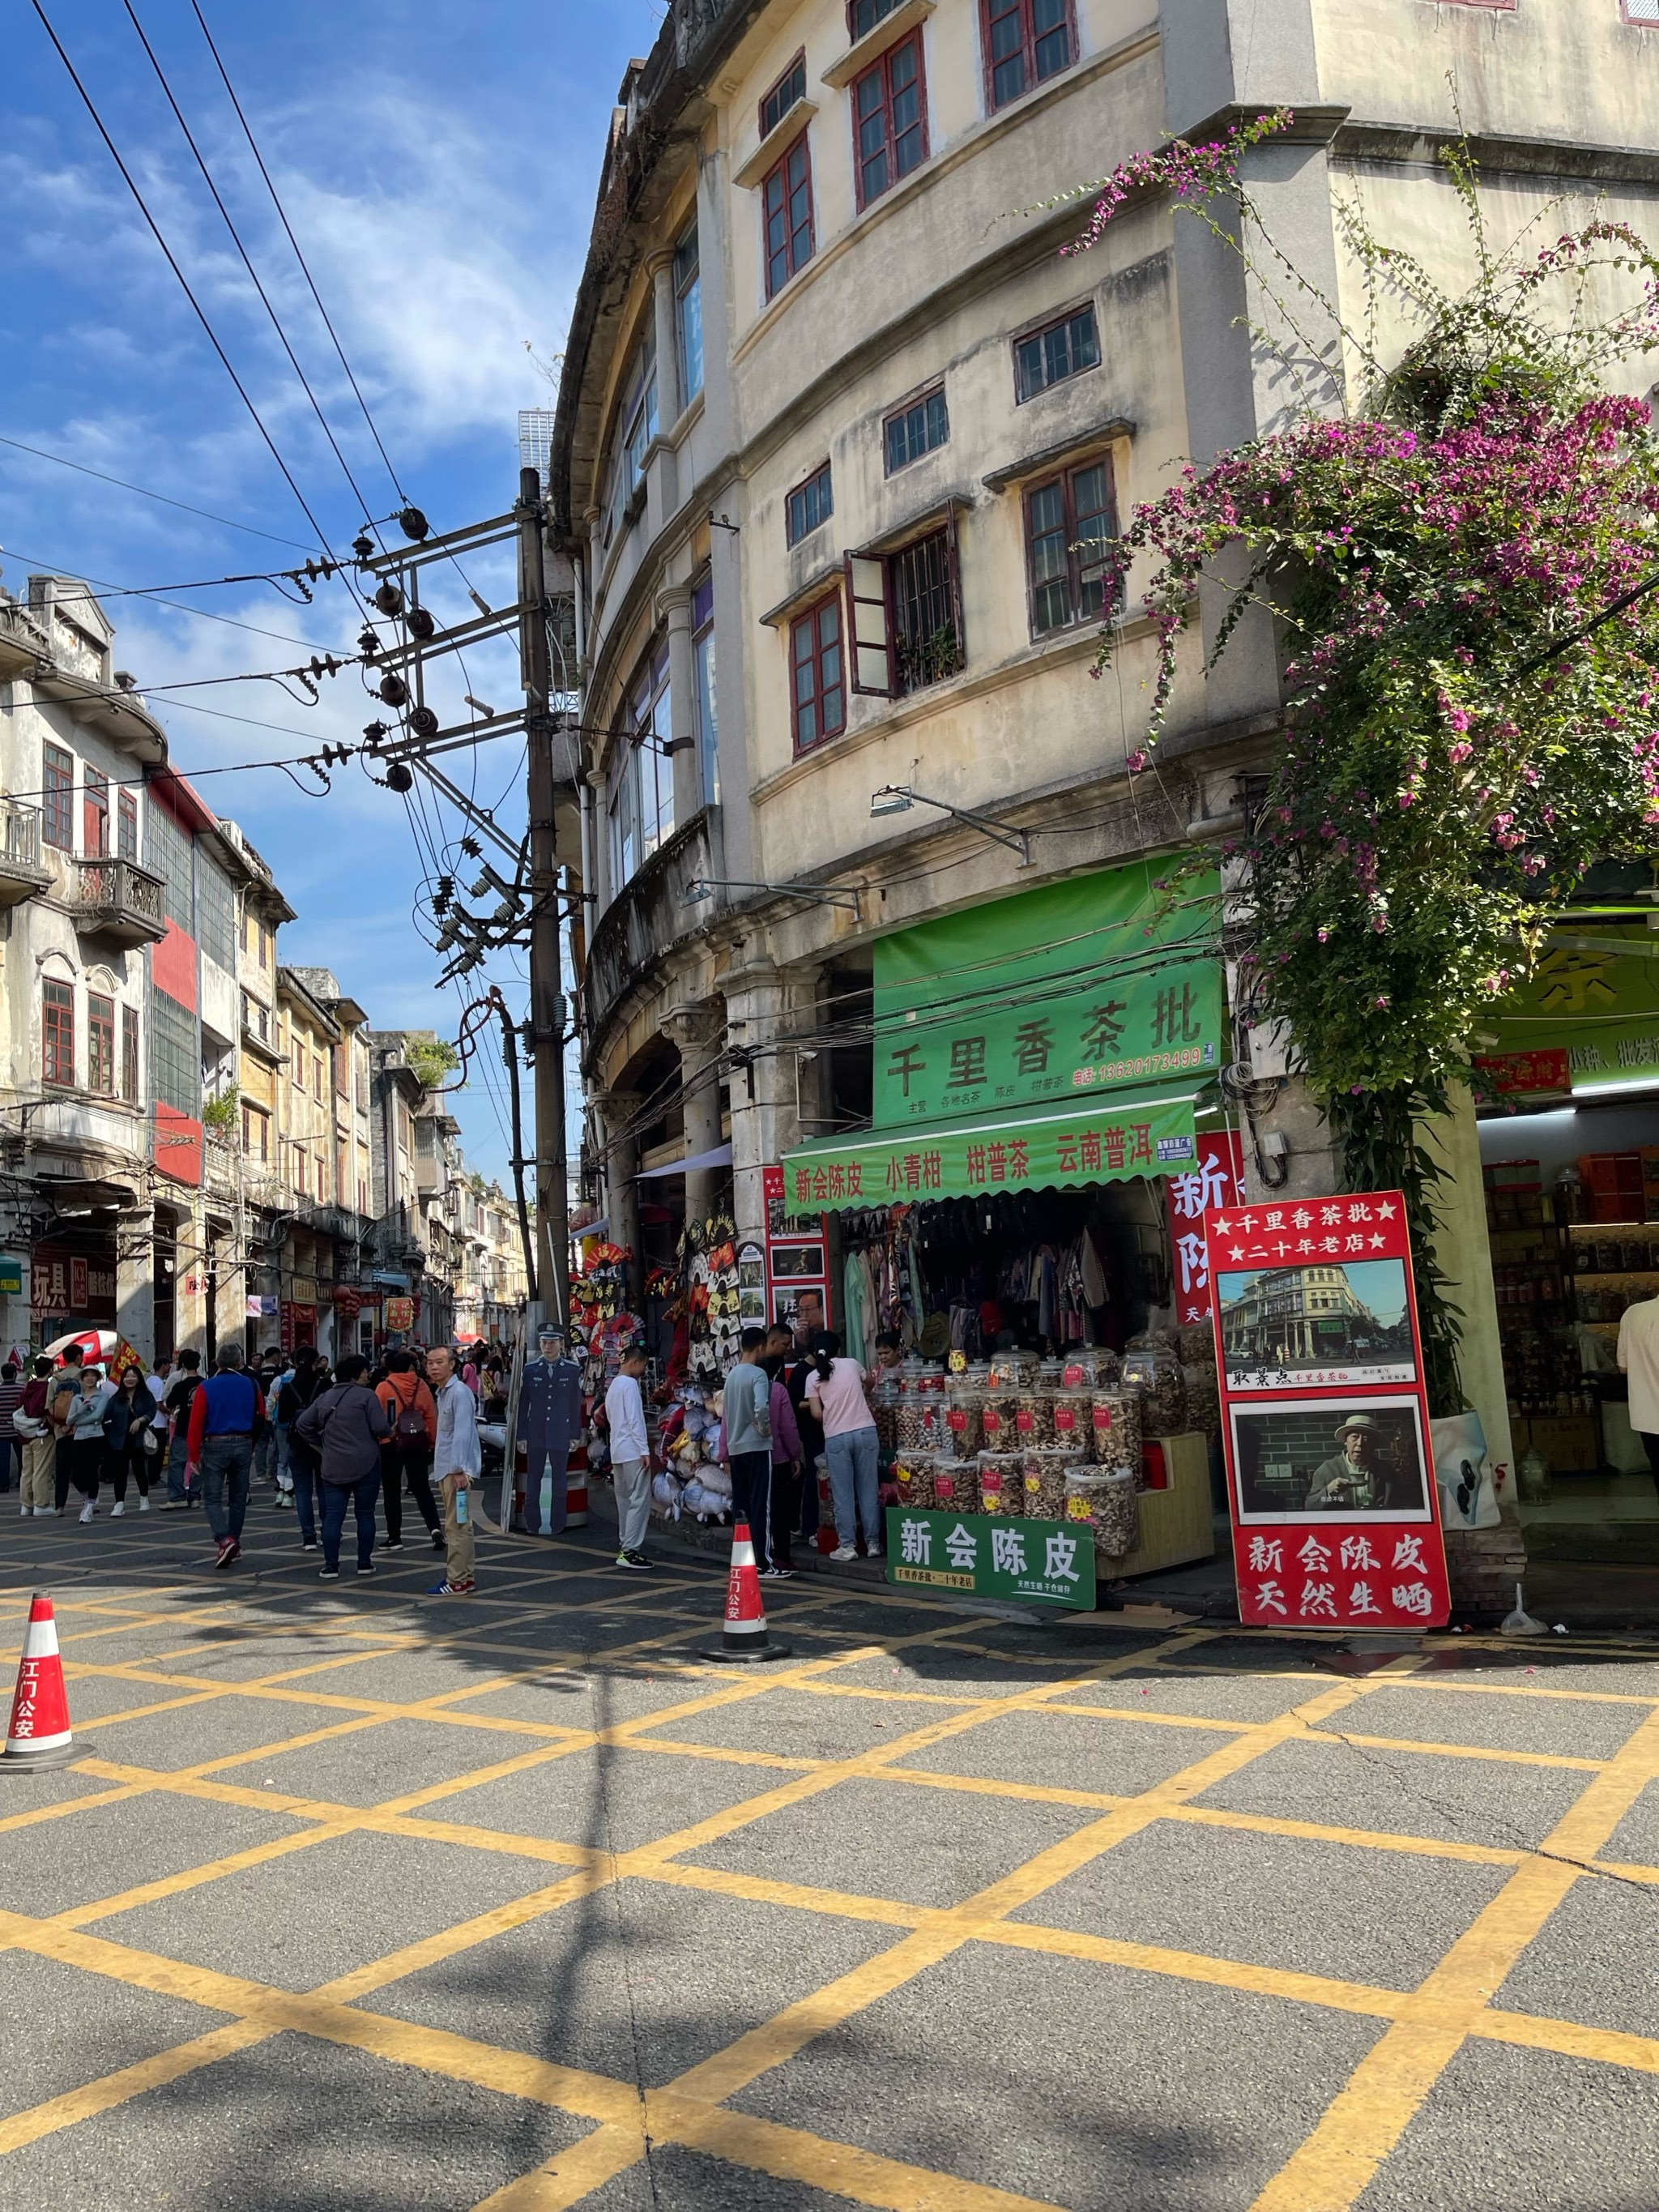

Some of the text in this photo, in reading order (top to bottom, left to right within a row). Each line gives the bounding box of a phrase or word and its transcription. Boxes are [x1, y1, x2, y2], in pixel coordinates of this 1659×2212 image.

[887, 982, 1201, 1097] 千里香茶批
[909, 1076, 1064, 1115] 主营 各地名茶 陈皮 柑普茶
[795, 1123, 1153, 1203] 新会陈皮 小青柑 柑普茶 云南普洱
[1170, 1153, 1245, 1219] 新
[1235, 1202, 1373, 1235] 千里香茶批
[1247, 1233, 1364, 1259] 二十年老店
[33, 1263, 66, 1308] 玩具
[1232, 1367, 1349, 1387] 取景点 千里香茶批
[901, 1518, 1080, 1582] 新会陈皮
[1248, 1534, 1429, 1574] 新会陈皮
[727, 1567, 741, 1619] 江门公安
[1017, 1580, 1043, 1591] 天然生晒
[1255, 1579, 1432, 1618] 天然生晒
[15, 1661, 40, 1738] 江门公安
